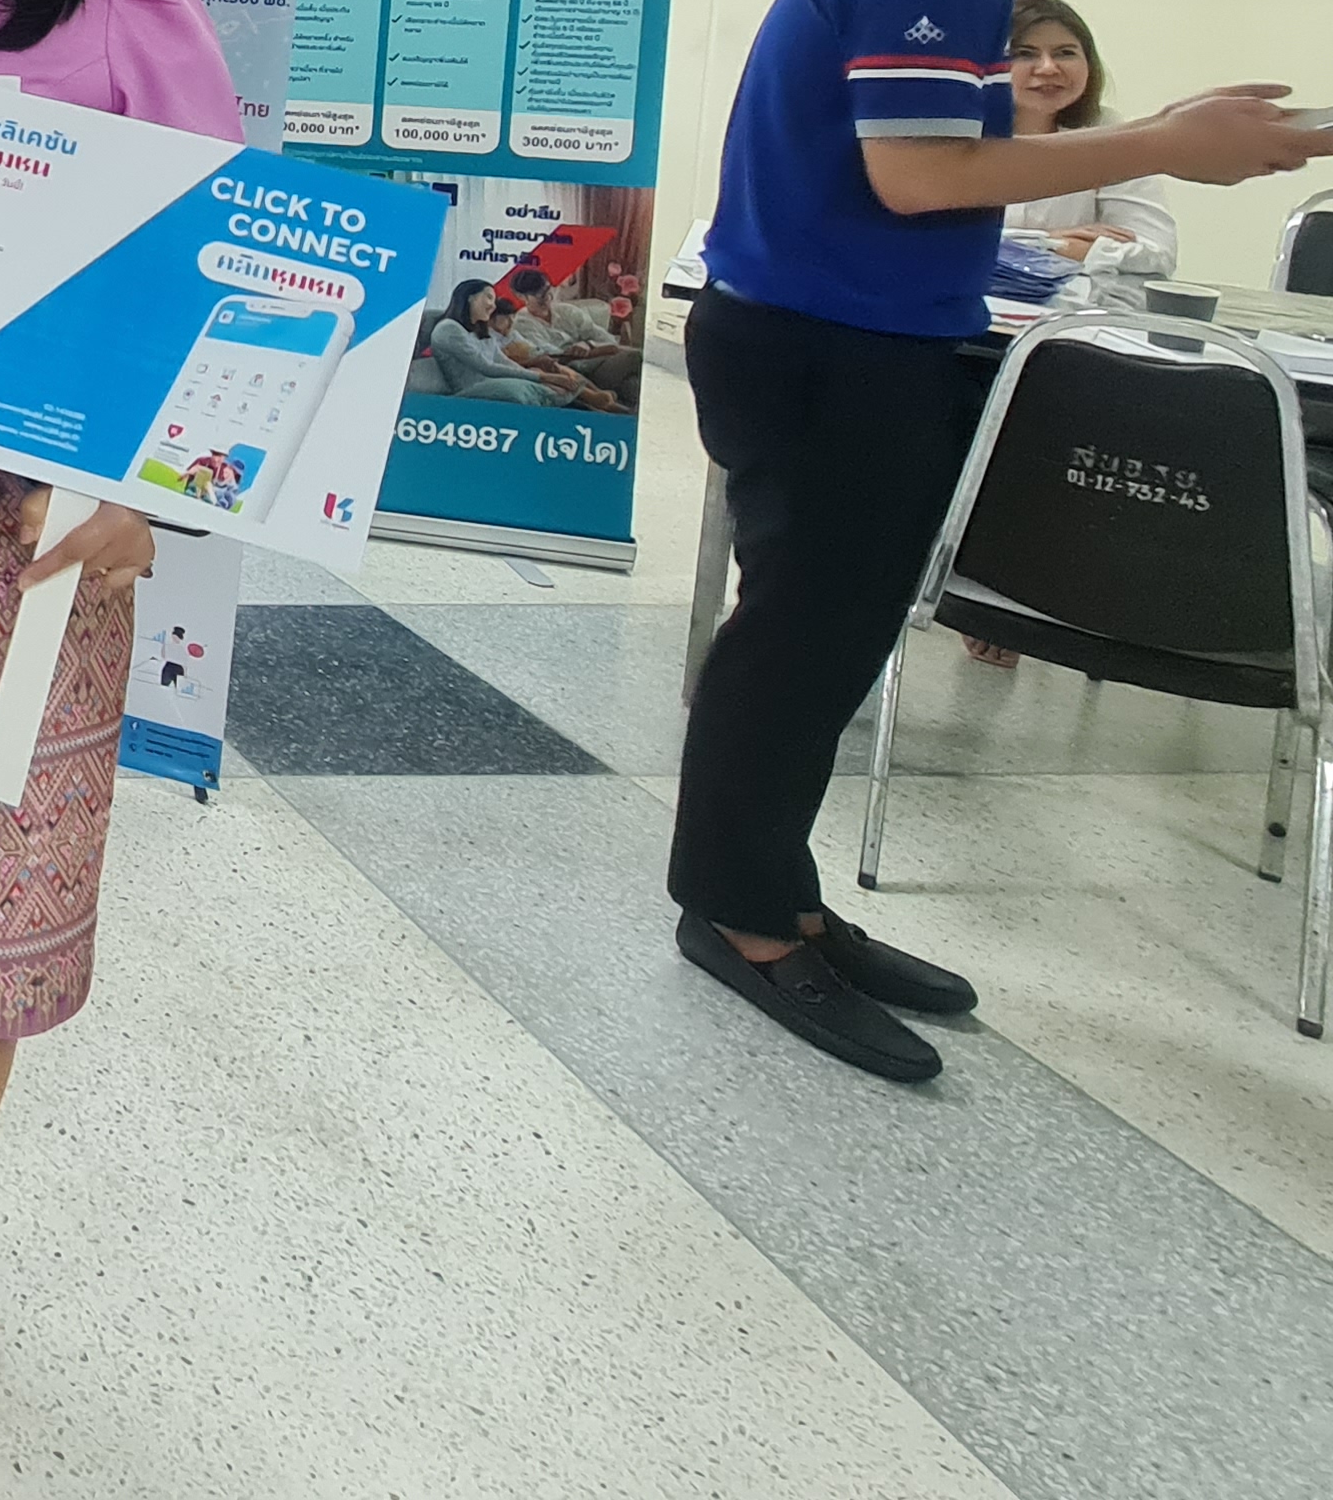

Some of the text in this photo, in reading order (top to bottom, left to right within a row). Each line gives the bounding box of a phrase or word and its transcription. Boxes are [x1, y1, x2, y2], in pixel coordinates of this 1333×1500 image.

[211, 176, 366, 234] CLICK TO
[505, 204, 561, 220] อย่าลืม
[228, 214, 397, 273] CONNECT
[216, 253, 346, 300] คลิกชุมชน
[395, 416, 630, 471] 694987 (เจได)
